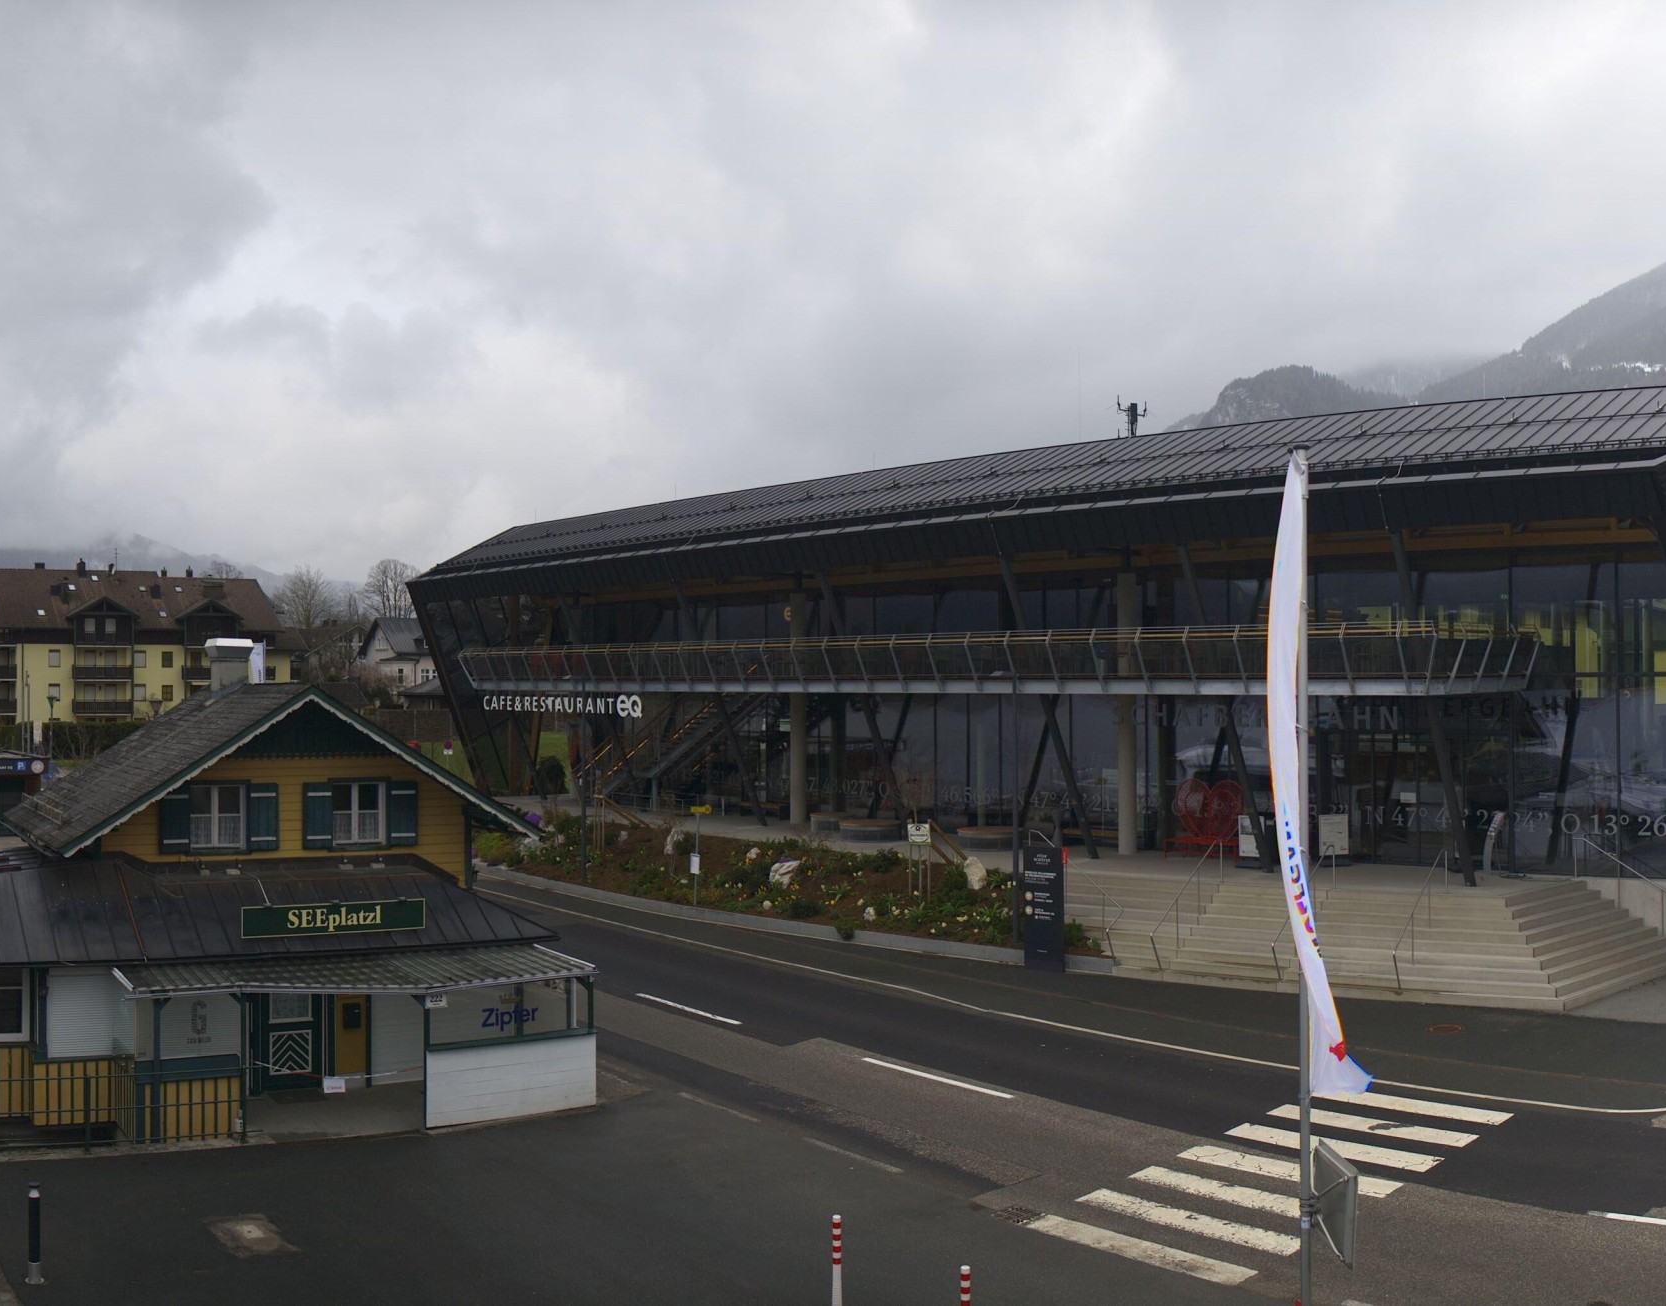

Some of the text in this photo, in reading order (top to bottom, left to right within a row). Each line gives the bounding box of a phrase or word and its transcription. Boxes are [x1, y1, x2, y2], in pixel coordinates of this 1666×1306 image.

[287, 905, 381, 931] SEEplatzl
[430, 994, 443, 1003] 222
[481, 1005, 539, 1031] Zipfer
